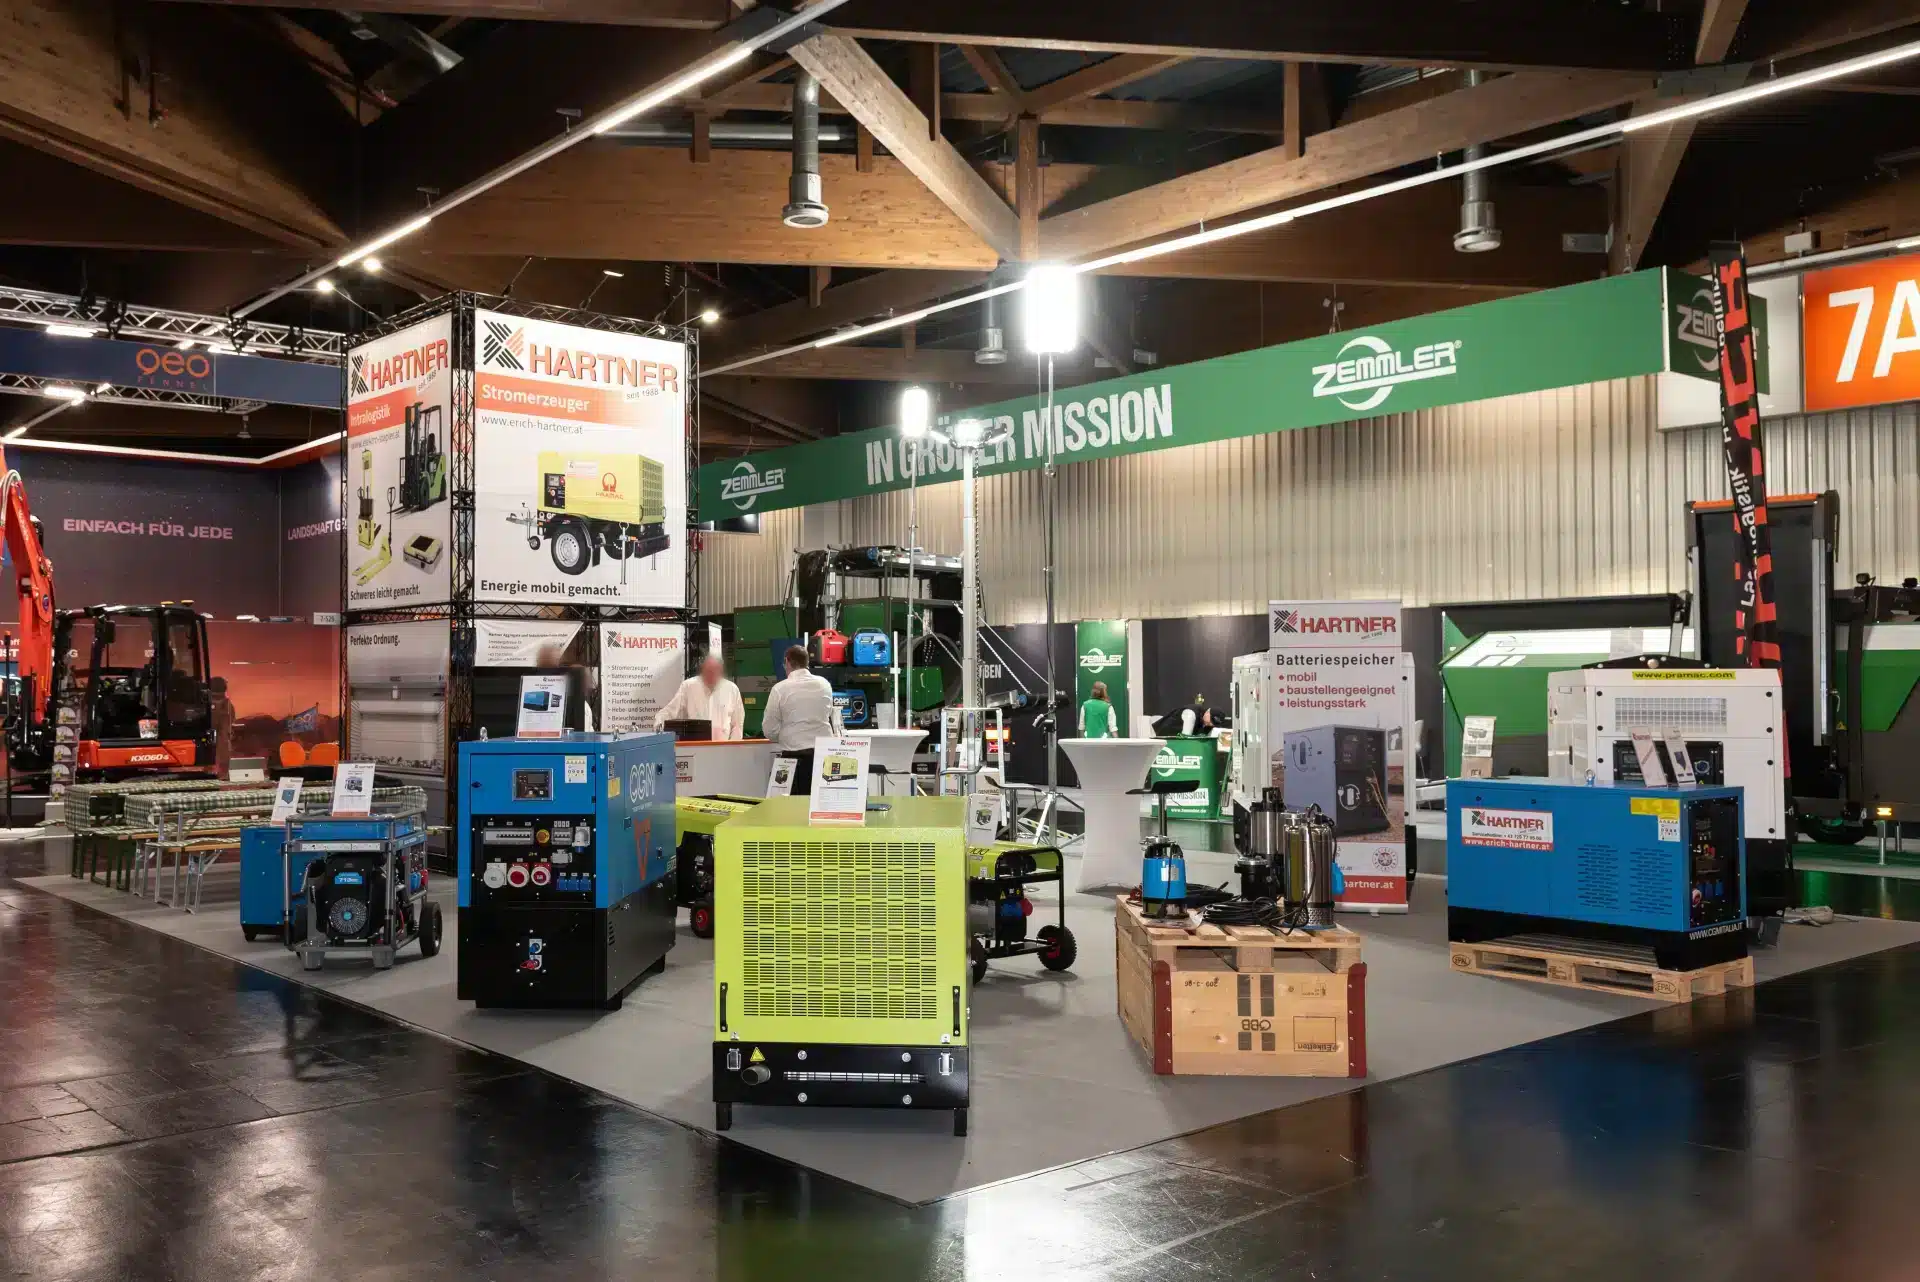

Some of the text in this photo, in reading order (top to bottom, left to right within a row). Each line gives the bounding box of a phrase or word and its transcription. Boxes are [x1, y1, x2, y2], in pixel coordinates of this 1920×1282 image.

[1829, 280, 1920, 383] 7A
[371, 339, 448, 391] HARTNER
[530, 343, 678, 393] HARTNER
[481, 384, 590, 413] Stromerzeuger
[351, 404, 391, 426] Intralogistik
[481, 416, 583, 435] www.erich-hartner.at
[866, 438, 894, 485] IN
[1023, 384, 1173, 460] MISSION
[64, 518, 233, 540] EINFACH FÜR JEDE
[288, 519, 334, 541] LANDSCHAFT
[350, 585, 421, 600] Schweres leicht gemacht.
[480, 580, 621, 597] Energie mobil gemacht.
[1300, 616, 1397, 633] HARTNER
[350, 633, 401, 646] Perfekte Ordnung.
[623, 637, 678, 649] HARTNER
[1276, 654, 1396, 668] Batteriespeicher
[1286, 672, 1317, 682] mobil
[1286, 685, 1396, 696] baustellengeeignet
[1286, 698, 1367, 710] leistungsstark
[1487, 815, 1544, 830] HARTNER
[1465, 838, 1551, 850] www.erich-hartner.at
[1689, 922, 1744, 940] WWW.CGMITALIA.IT
[1657, 983, 1673, 991] EPAL
